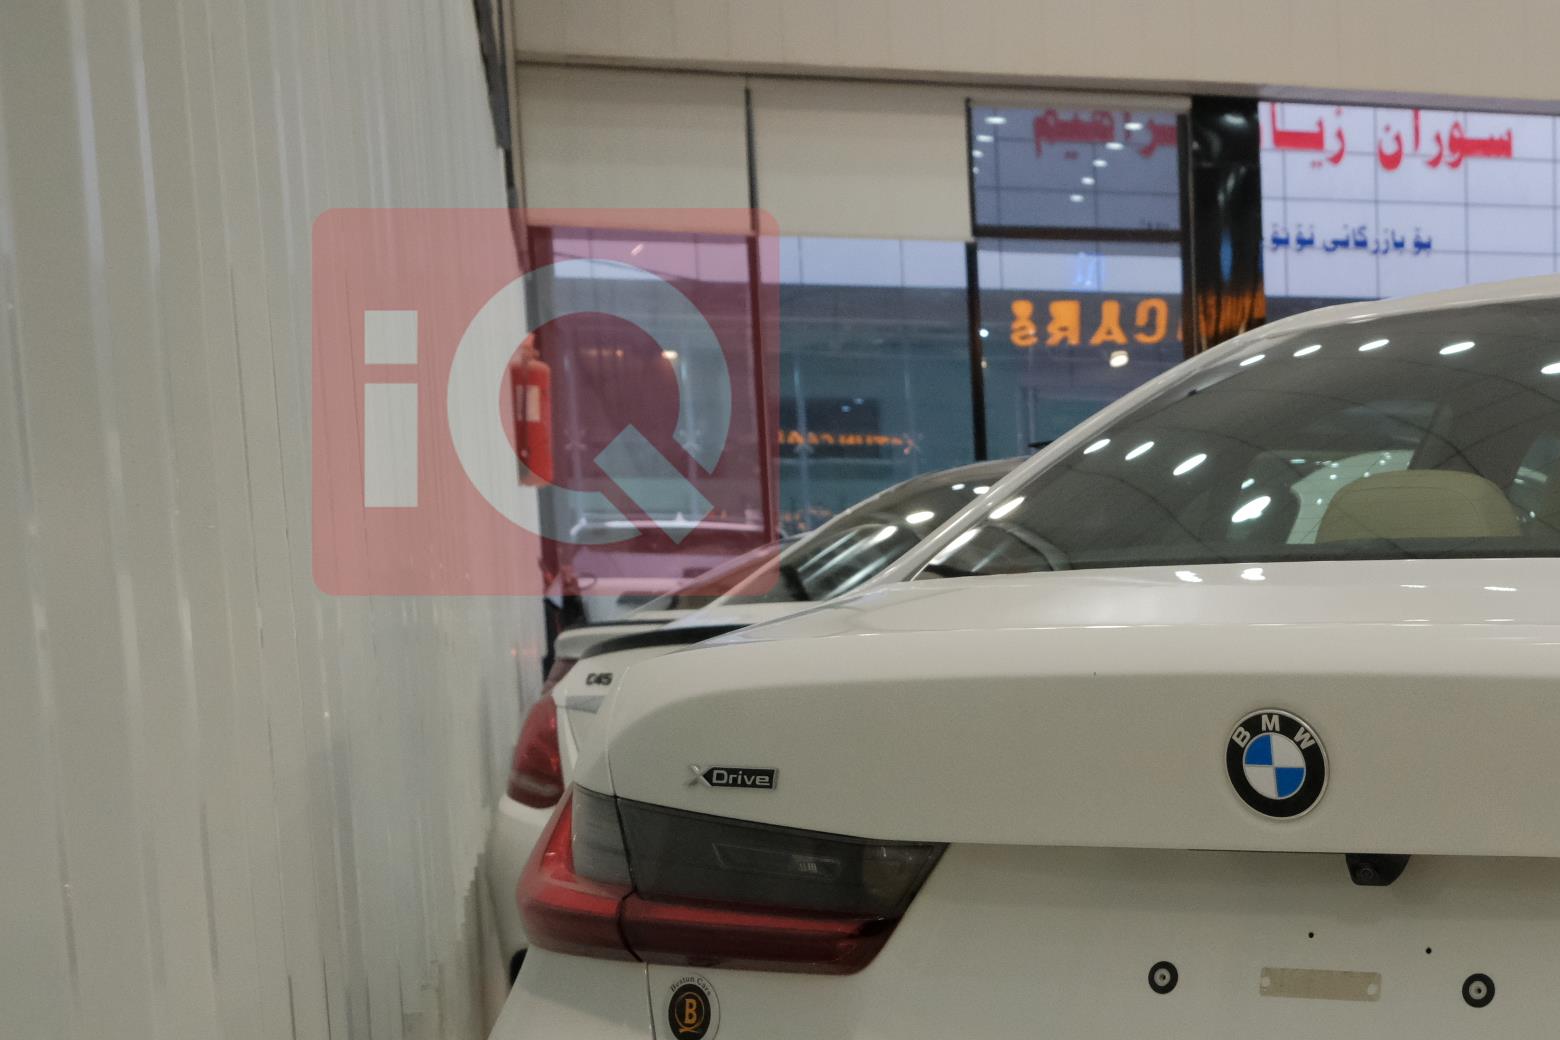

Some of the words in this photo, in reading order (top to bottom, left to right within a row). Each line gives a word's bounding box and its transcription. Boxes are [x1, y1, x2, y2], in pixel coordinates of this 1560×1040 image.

[1258, 101, 1346, 170] زيا
[1231, 713, 1317, 751] BMW
[683, 998, 698, 1026] B
